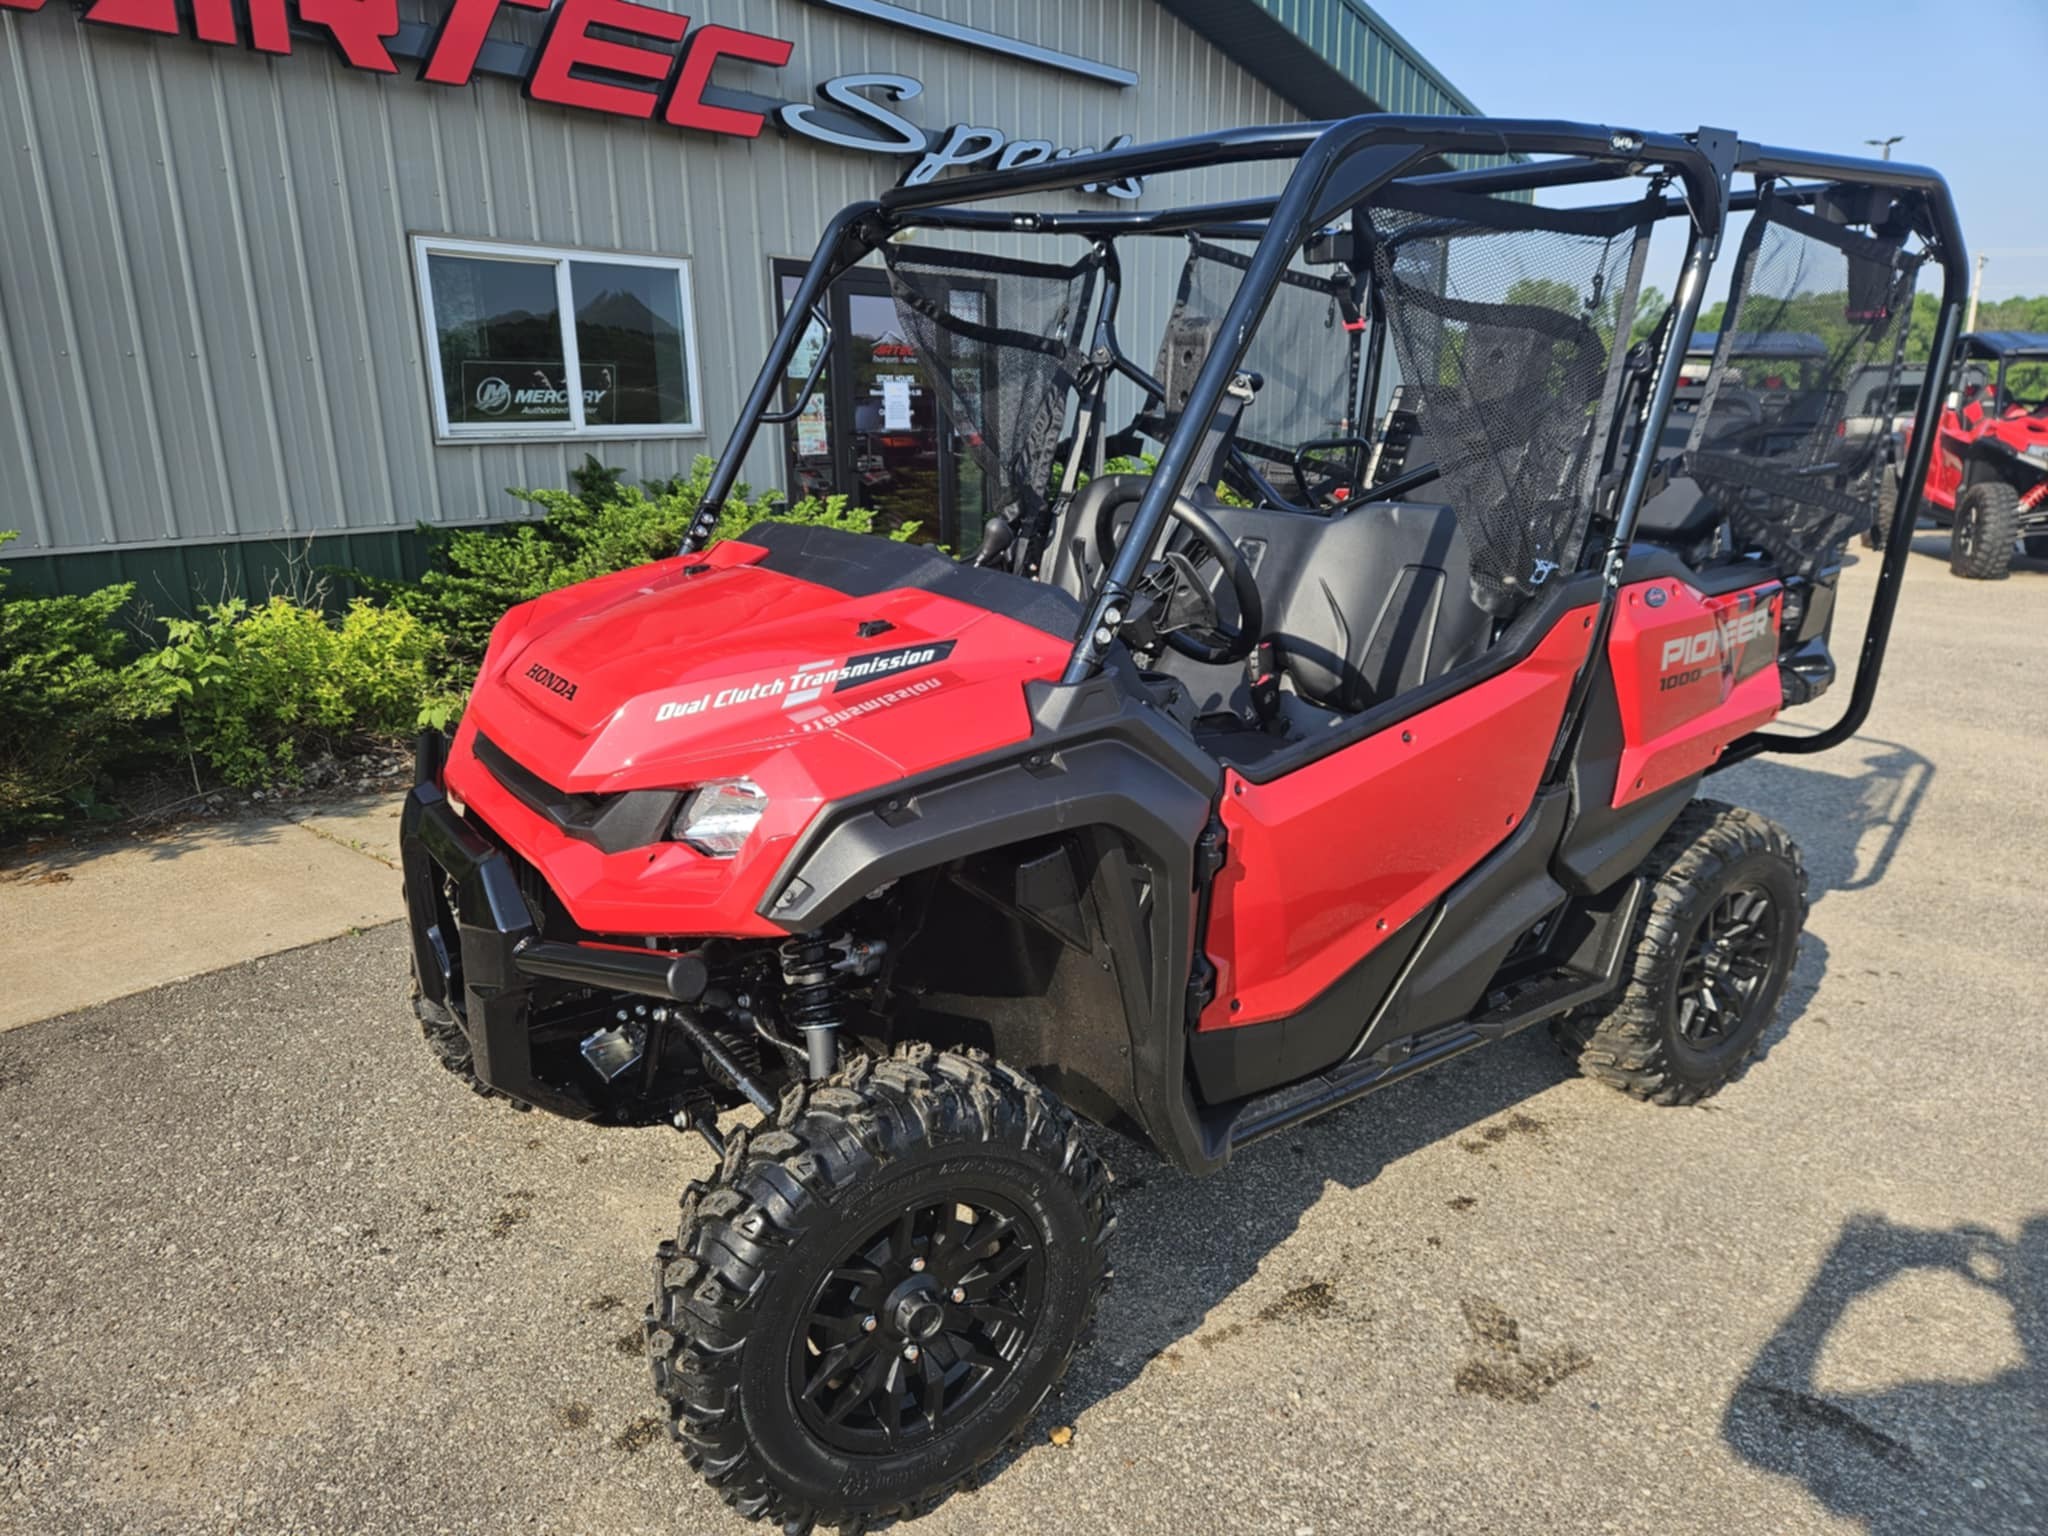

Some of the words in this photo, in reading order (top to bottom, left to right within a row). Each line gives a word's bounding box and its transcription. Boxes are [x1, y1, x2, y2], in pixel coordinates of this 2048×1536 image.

[0, 0, 796, 138] RTEC
[515, 389, 606, 404] MERCRY
[1661, 607, 1769, 672] PIONEER
[525, 663, 578, 701] HONDA
[655, 695, 710, 722] Dual
[712, 678, 785, 709] Clutch
[789, 649, 936, 692] Transmission
[1660, 668, 1702, 692] 1000
